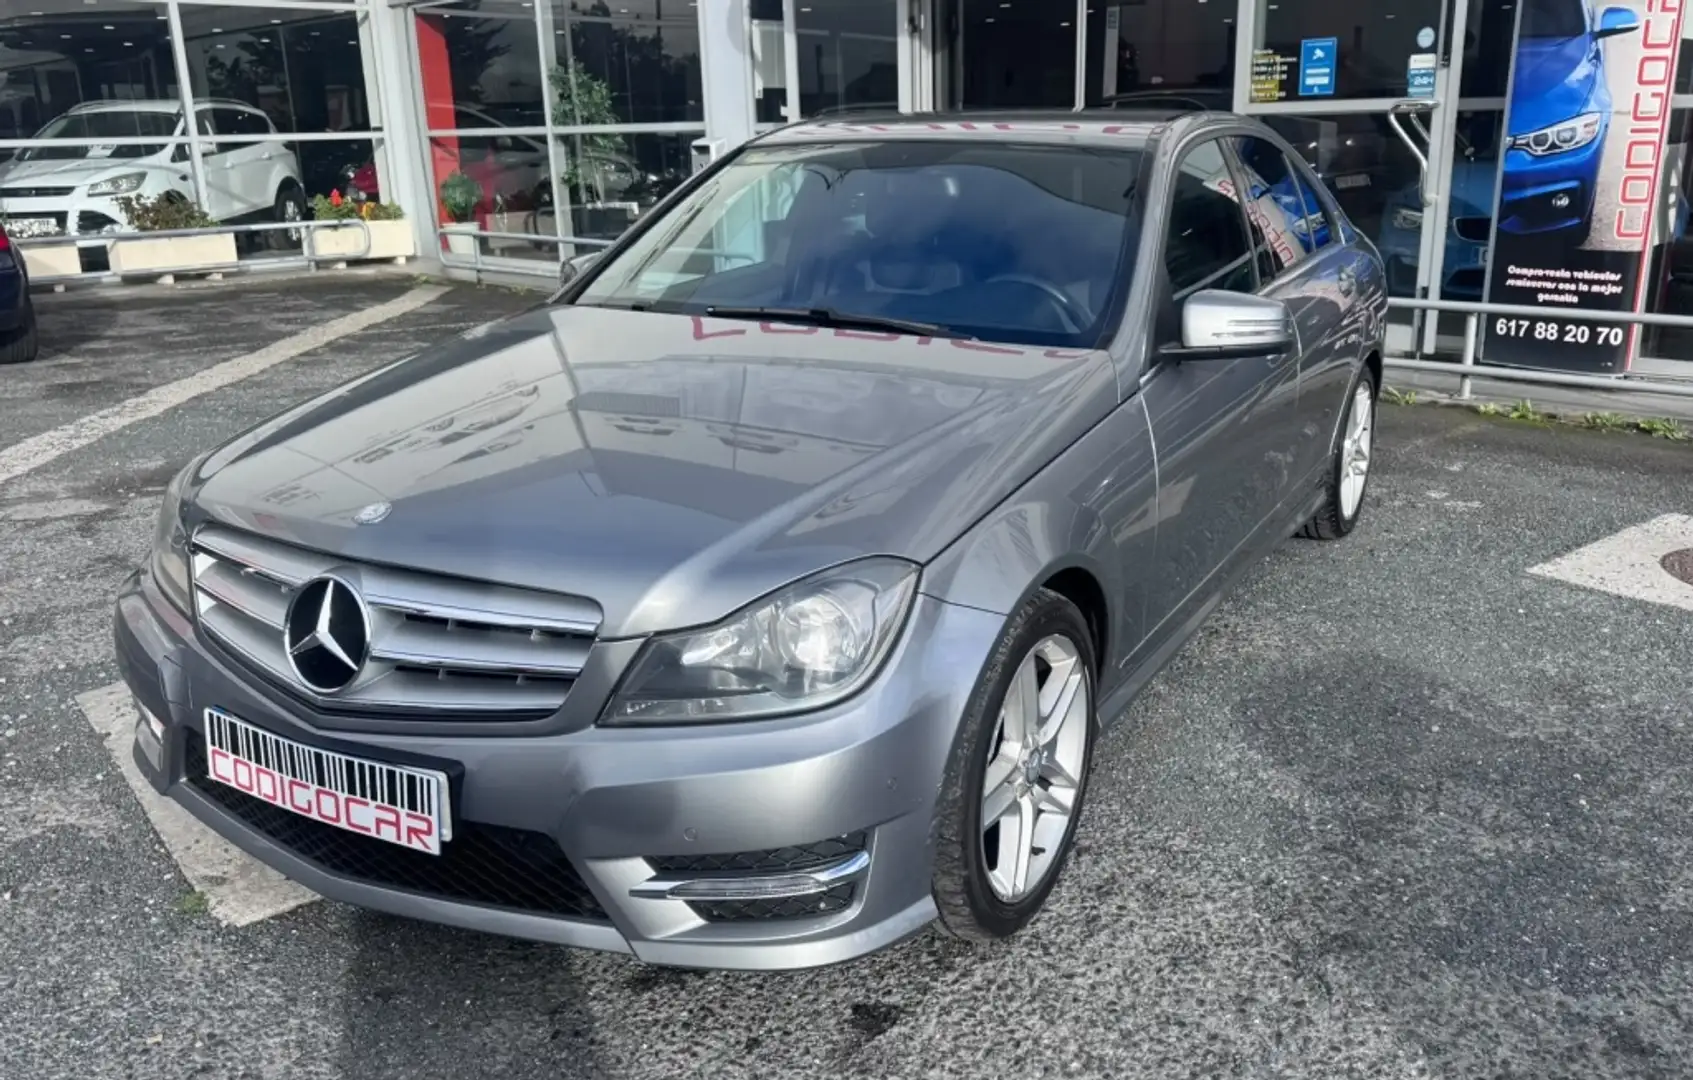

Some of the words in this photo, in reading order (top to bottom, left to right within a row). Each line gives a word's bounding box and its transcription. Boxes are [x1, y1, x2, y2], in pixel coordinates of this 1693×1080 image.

[1577, 282, 1589, 292] la
[1591, 284, 1623, 295] mejor
[1496, 318, 1530, 338] 617
[1534, 321, 1558, 341] 88
[1563, 324, 1590, 344] 20
[1595, 326, 1623, 346] 70
[211, 748, 433, 851] CODIGOCAR
